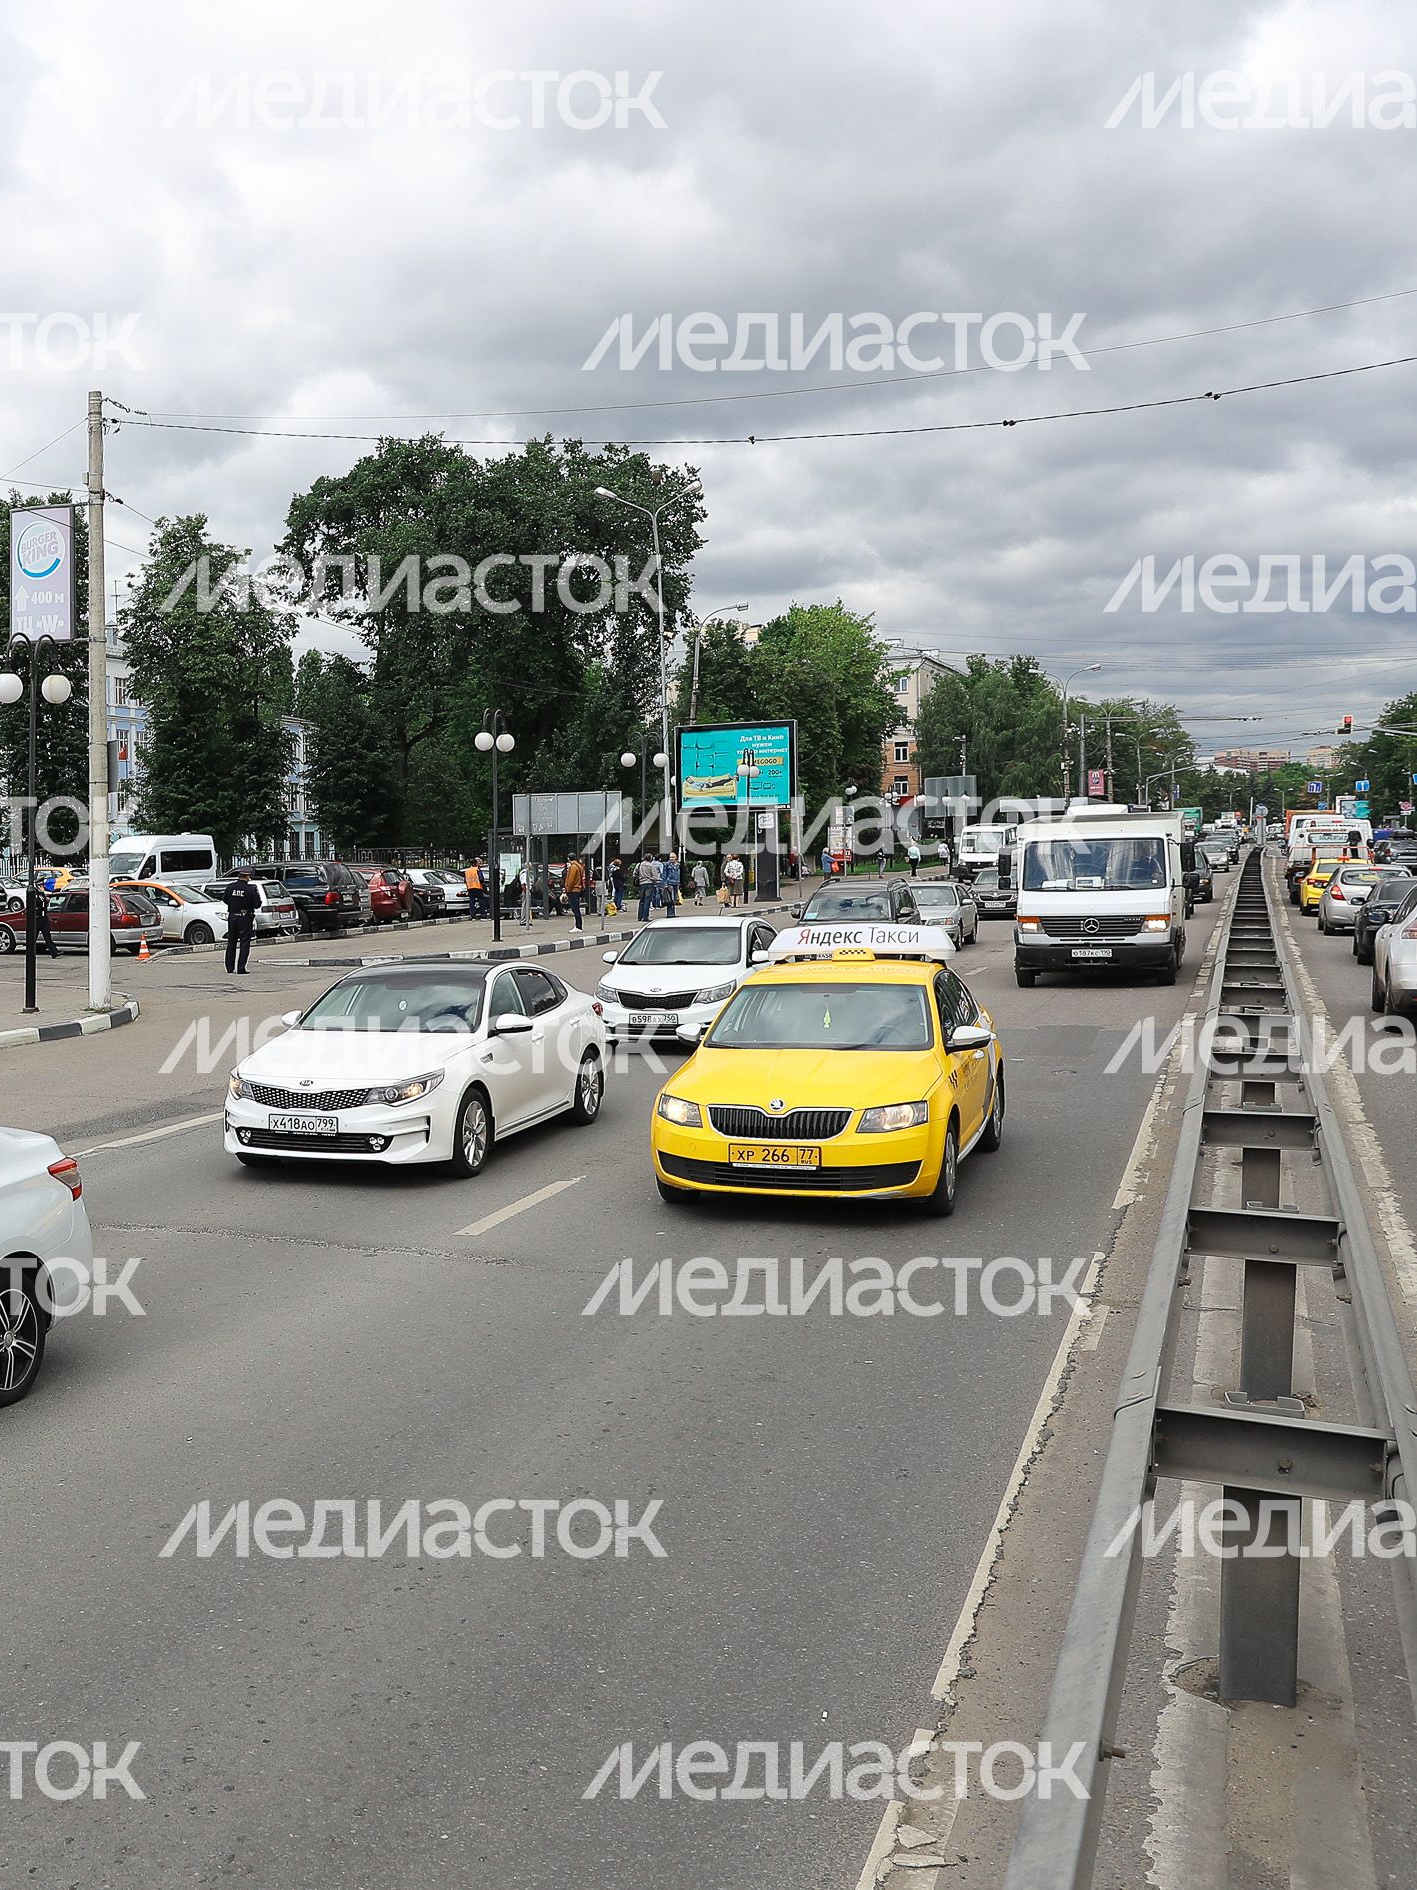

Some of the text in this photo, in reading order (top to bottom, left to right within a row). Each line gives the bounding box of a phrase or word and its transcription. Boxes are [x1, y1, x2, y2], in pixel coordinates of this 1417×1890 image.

[21, 530, 57, 552] BURGER
[22, 541, 59, 566] KING
[31, 591, 53, 604] 400
[798, 926, 919, 946] Яндекс Такси
[762, 1148, 790, 1162] 266
[799, 1149, 814, 1160] 77
